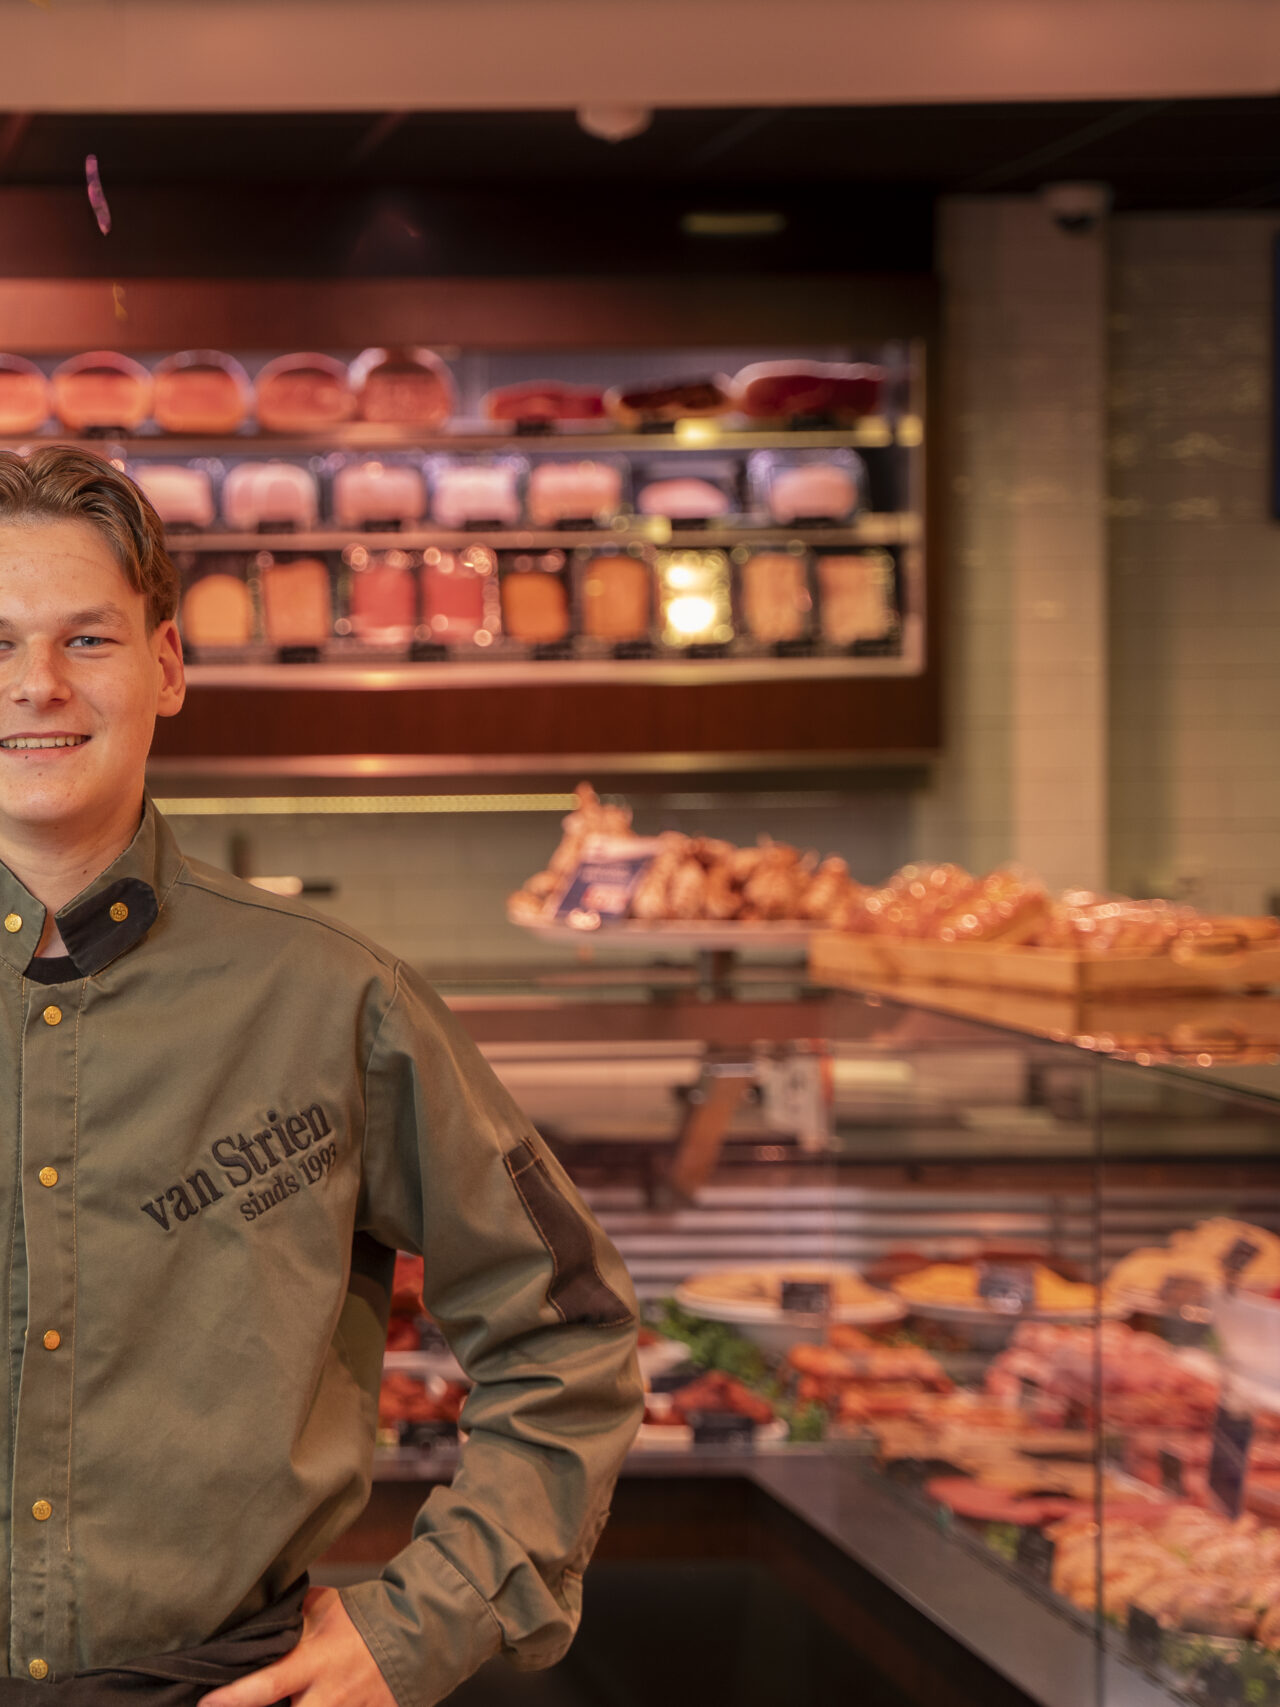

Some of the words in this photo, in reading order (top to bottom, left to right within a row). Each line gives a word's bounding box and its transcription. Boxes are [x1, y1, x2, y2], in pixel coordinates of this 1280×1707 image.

[140, 1168, 224, 1231] van
[211, 1103, 332, 1188] Strien
[239, 1173, 301, 1221] sinds
